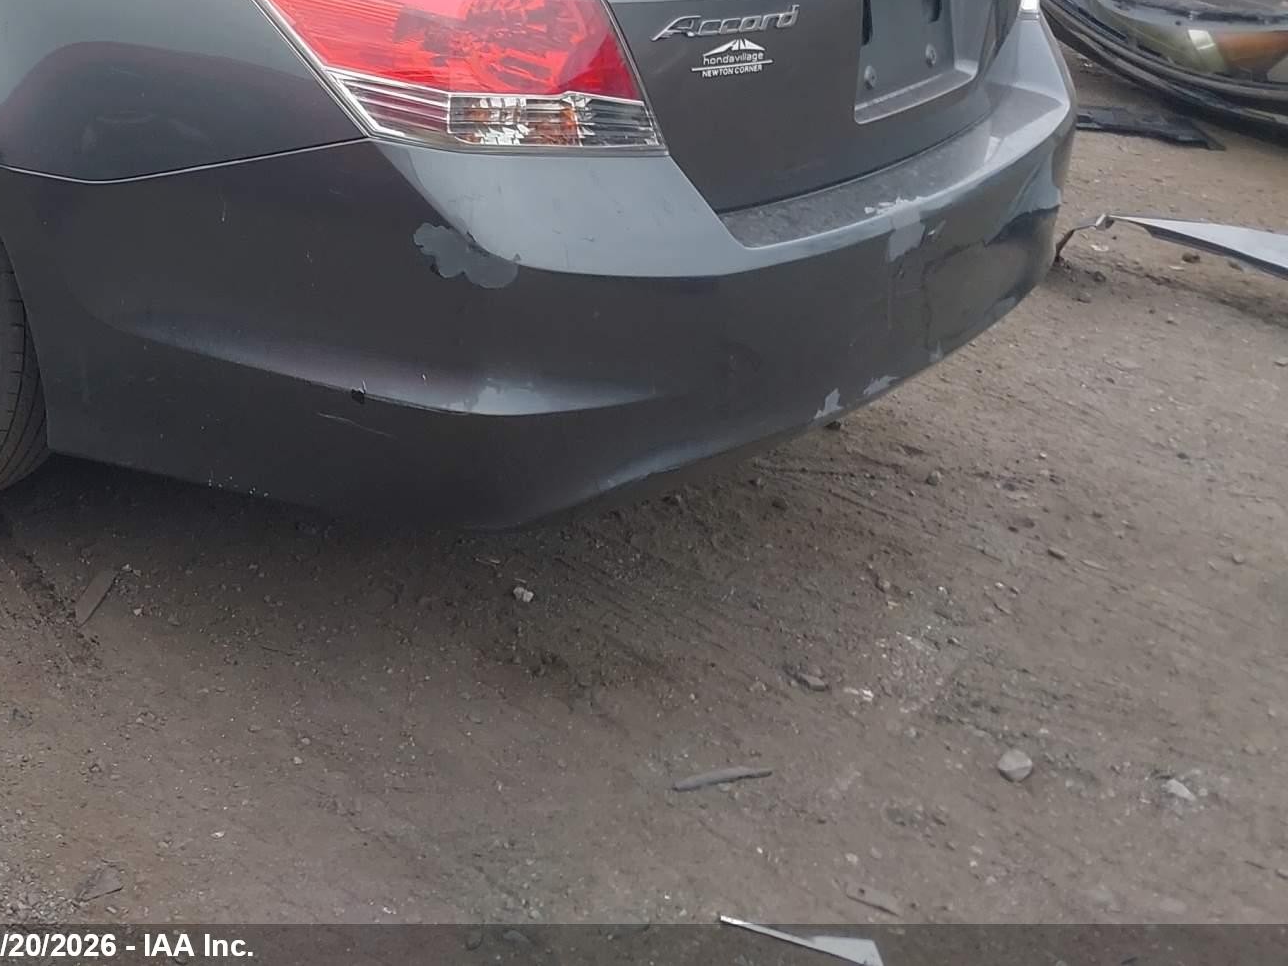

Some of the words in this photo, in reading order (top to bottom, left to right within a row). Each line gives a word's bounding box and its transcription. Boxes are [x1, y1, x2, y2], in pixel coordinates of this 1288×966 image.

[651, 4, 800, 41] Accord
[702, 67, 733, 78] NEWTON
[734, 64, 763, 75] CORNER
